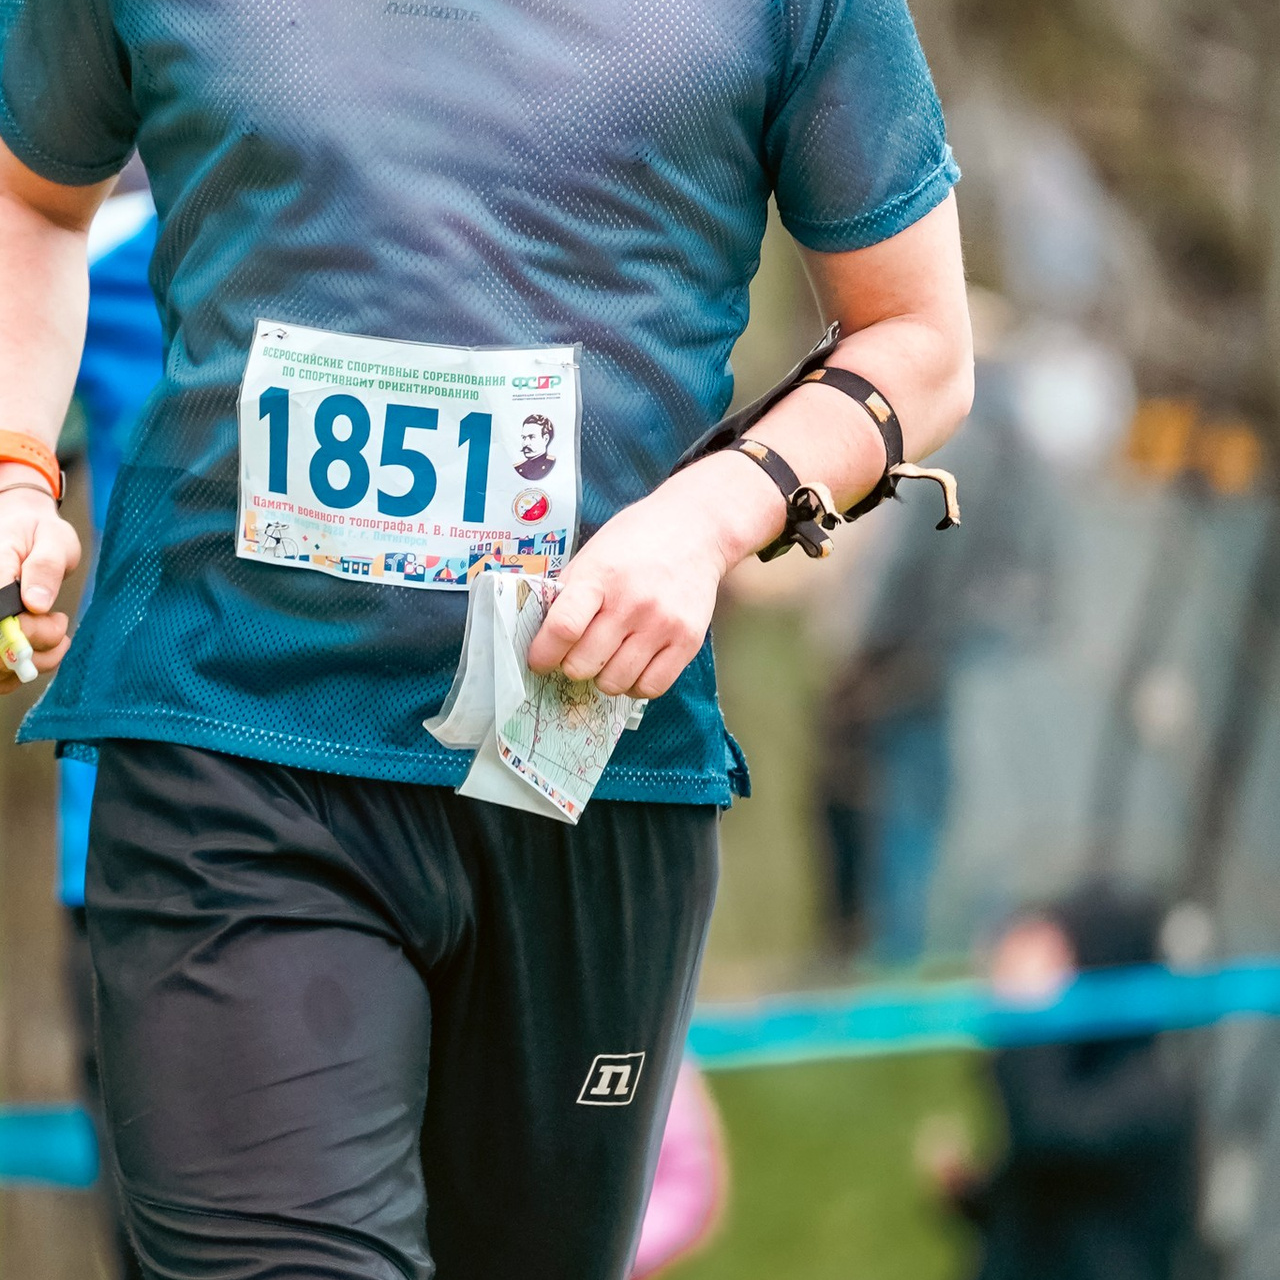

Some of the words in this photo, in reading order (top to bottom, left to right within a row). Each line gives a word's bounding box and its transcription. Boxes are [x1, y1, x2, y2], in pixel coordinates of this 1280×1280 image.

[263, 346, 344, 369] ВСЕРОССИЙСКИЕ
[347, 361, 419, 379] СПОРТИВНЫЕ
[423, 370, 507, 387] СОРЕВНОВАНИЯ
[282, 365, 297, 378] ПО
[299, 368, 374, 391] СПОРТИВНОМУ
[378, 380, 480, 401] ОРИЕНТИРОВАНИЮ
[259, 386, 493, 524] 1851
[253, 495, 295, 513] Памяти
[297, 505, 345, 525] военного
[349, 517, 413, 535] топографа
[417, 522, 428, 534] А.
[433, 524, 445, 536] В.
[449, 526, 512, 541] Пастухова
